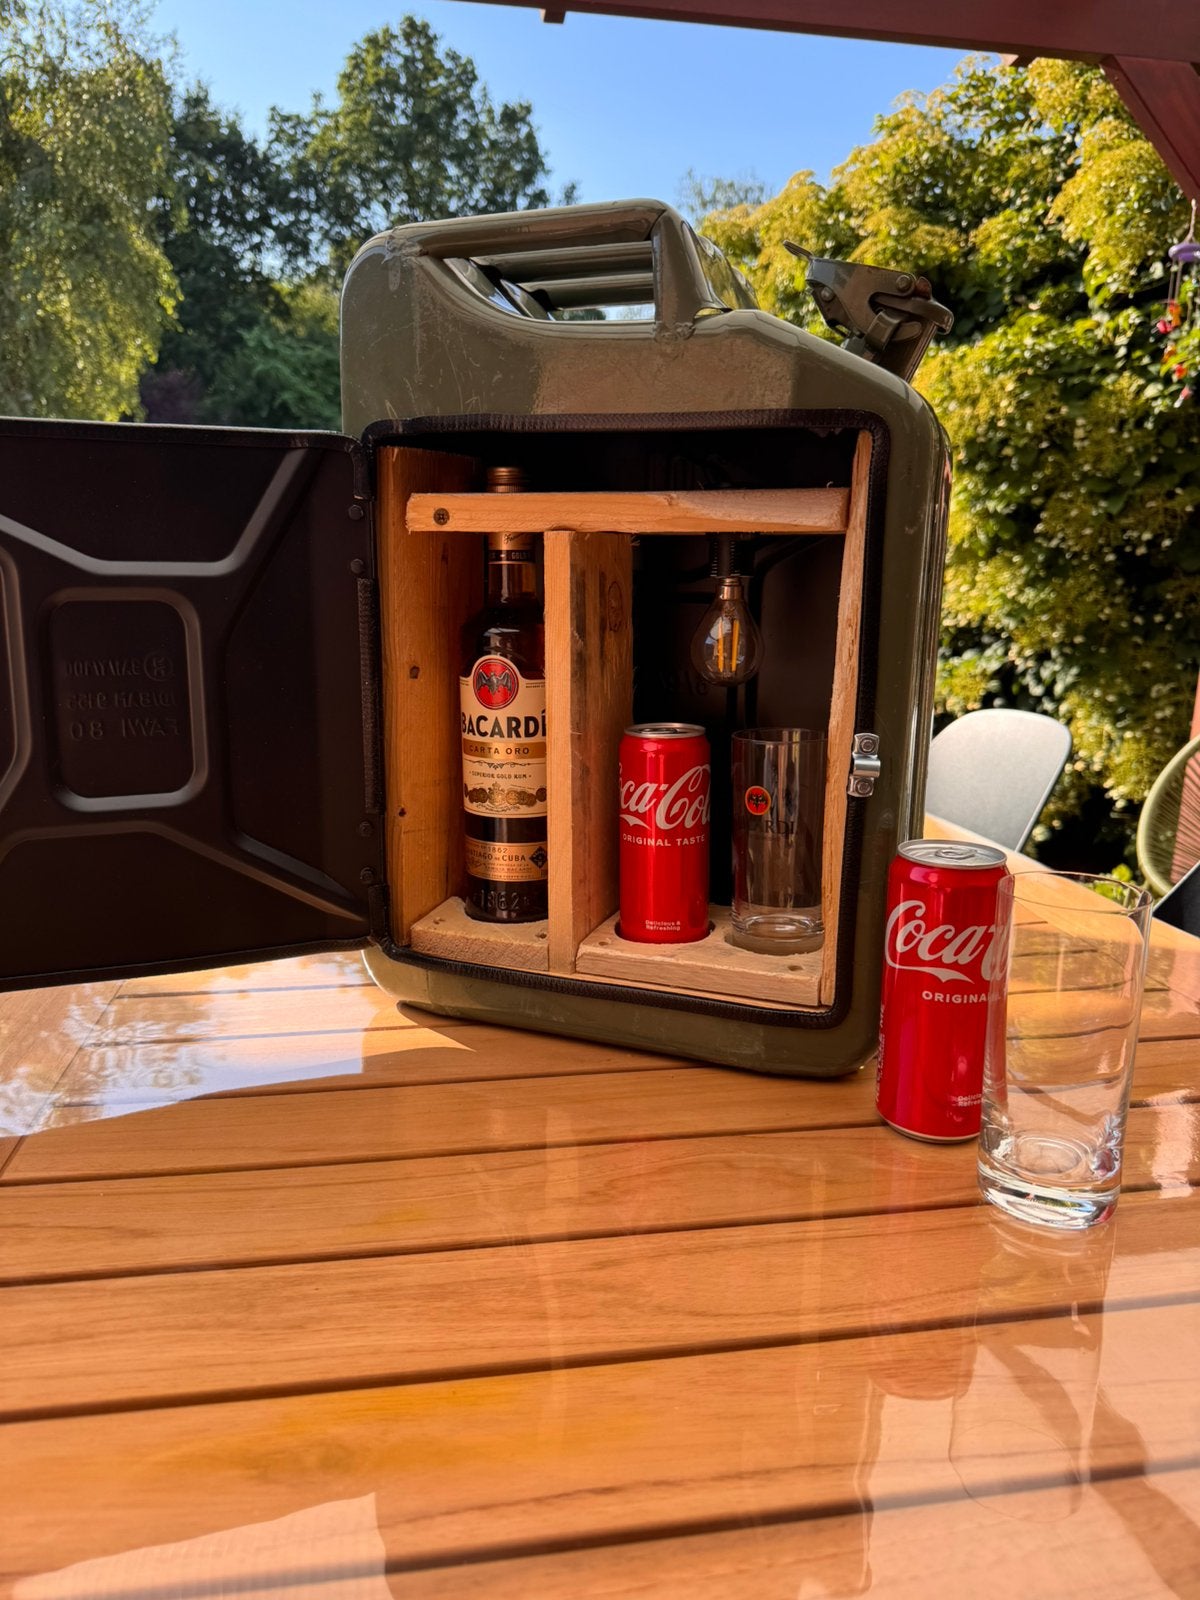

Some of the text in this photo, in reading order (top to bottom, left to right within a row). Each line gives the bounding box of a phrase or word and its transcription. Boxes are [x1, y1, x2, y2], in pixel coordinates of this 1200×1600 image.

[469, 745, 530, 755] CARTA ORO
[622, 834, 705, 847] ORIGINAL TASTE
